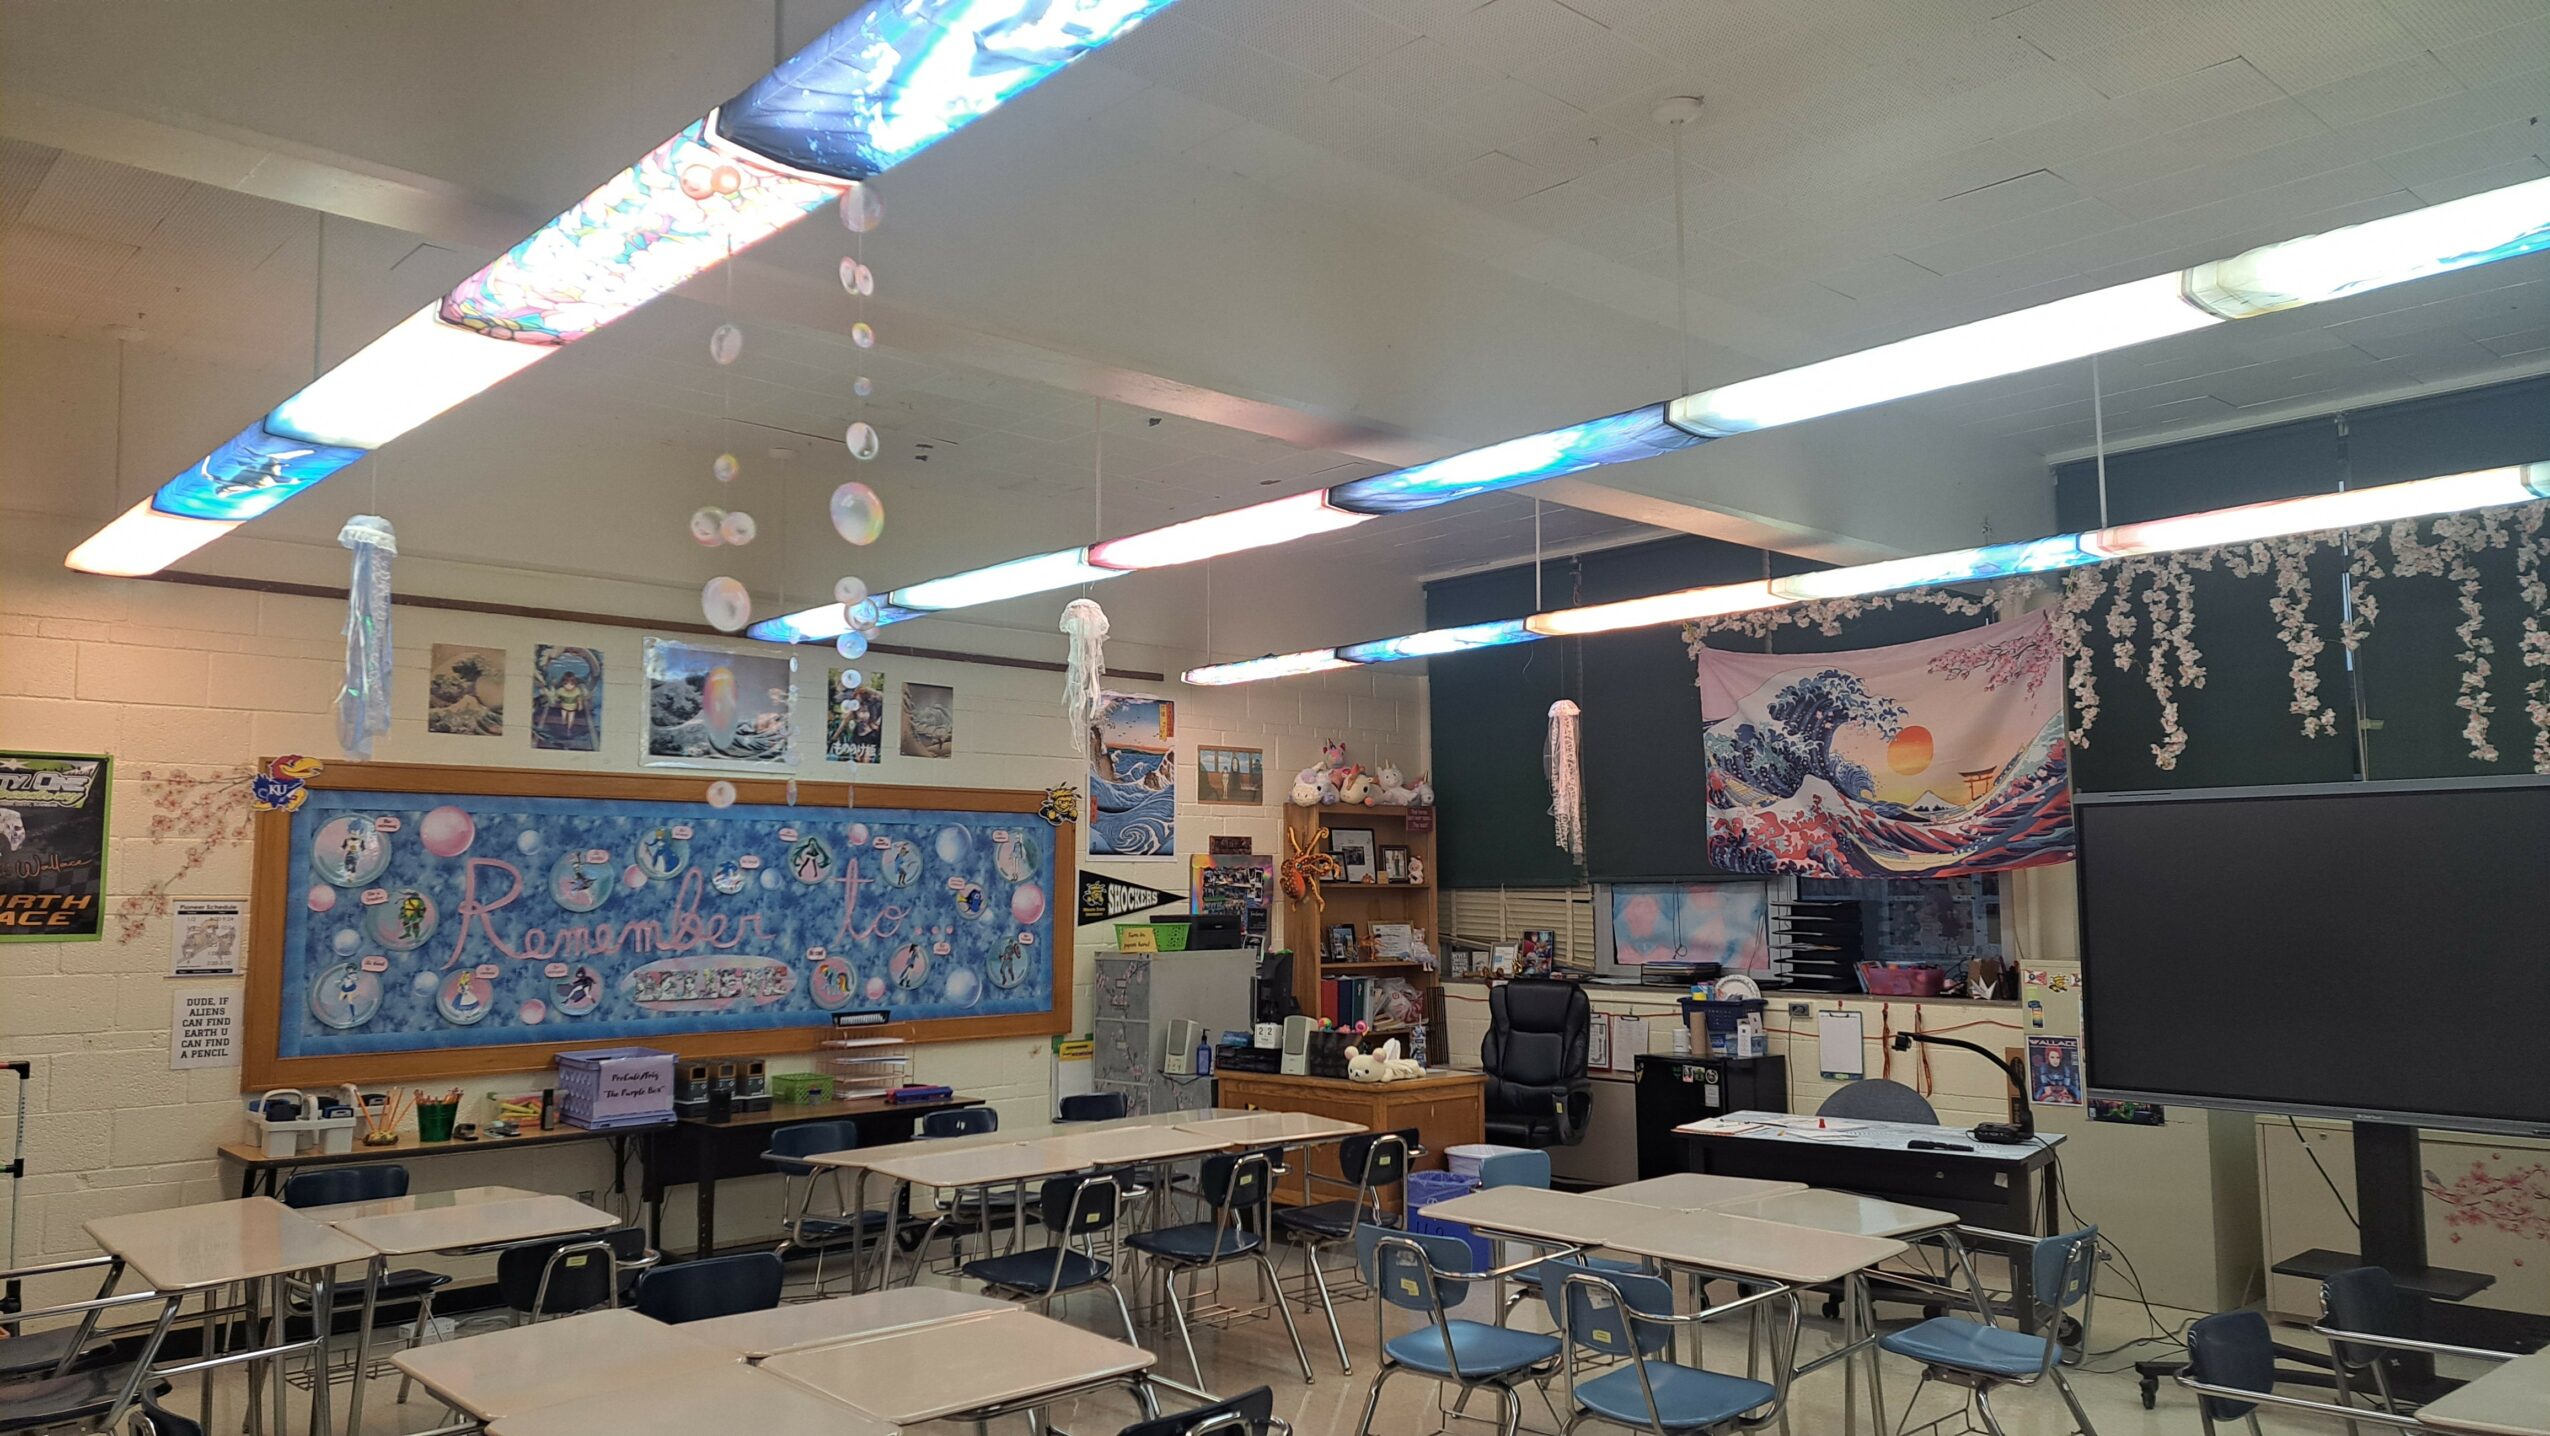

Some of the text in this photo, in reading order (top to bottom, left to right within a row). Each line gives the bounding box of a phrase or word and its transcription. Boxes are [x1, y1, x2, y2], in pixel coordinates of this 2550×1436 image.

[269, 785, 288, 796] KU
[16, 854, 92, 879] Wallace
[1108, 883, 1158, 916] SHOCKERS
[440, 857, 777, 970] Remember
[219, 997, 229, 1006] IF
[189, 1008, 225, 1016] ALIENS
[182, 1018, 231, 1027] CAN FIND
[184, 1028, 228, 1037] EARTH U
[181, 1038, 230, 1048] CAN FIND
[2029, 1039, 2078, 1047] WALLACE
[181, 1051, 187, 1059] A
[621, 1088, 646, 1098] Purple
